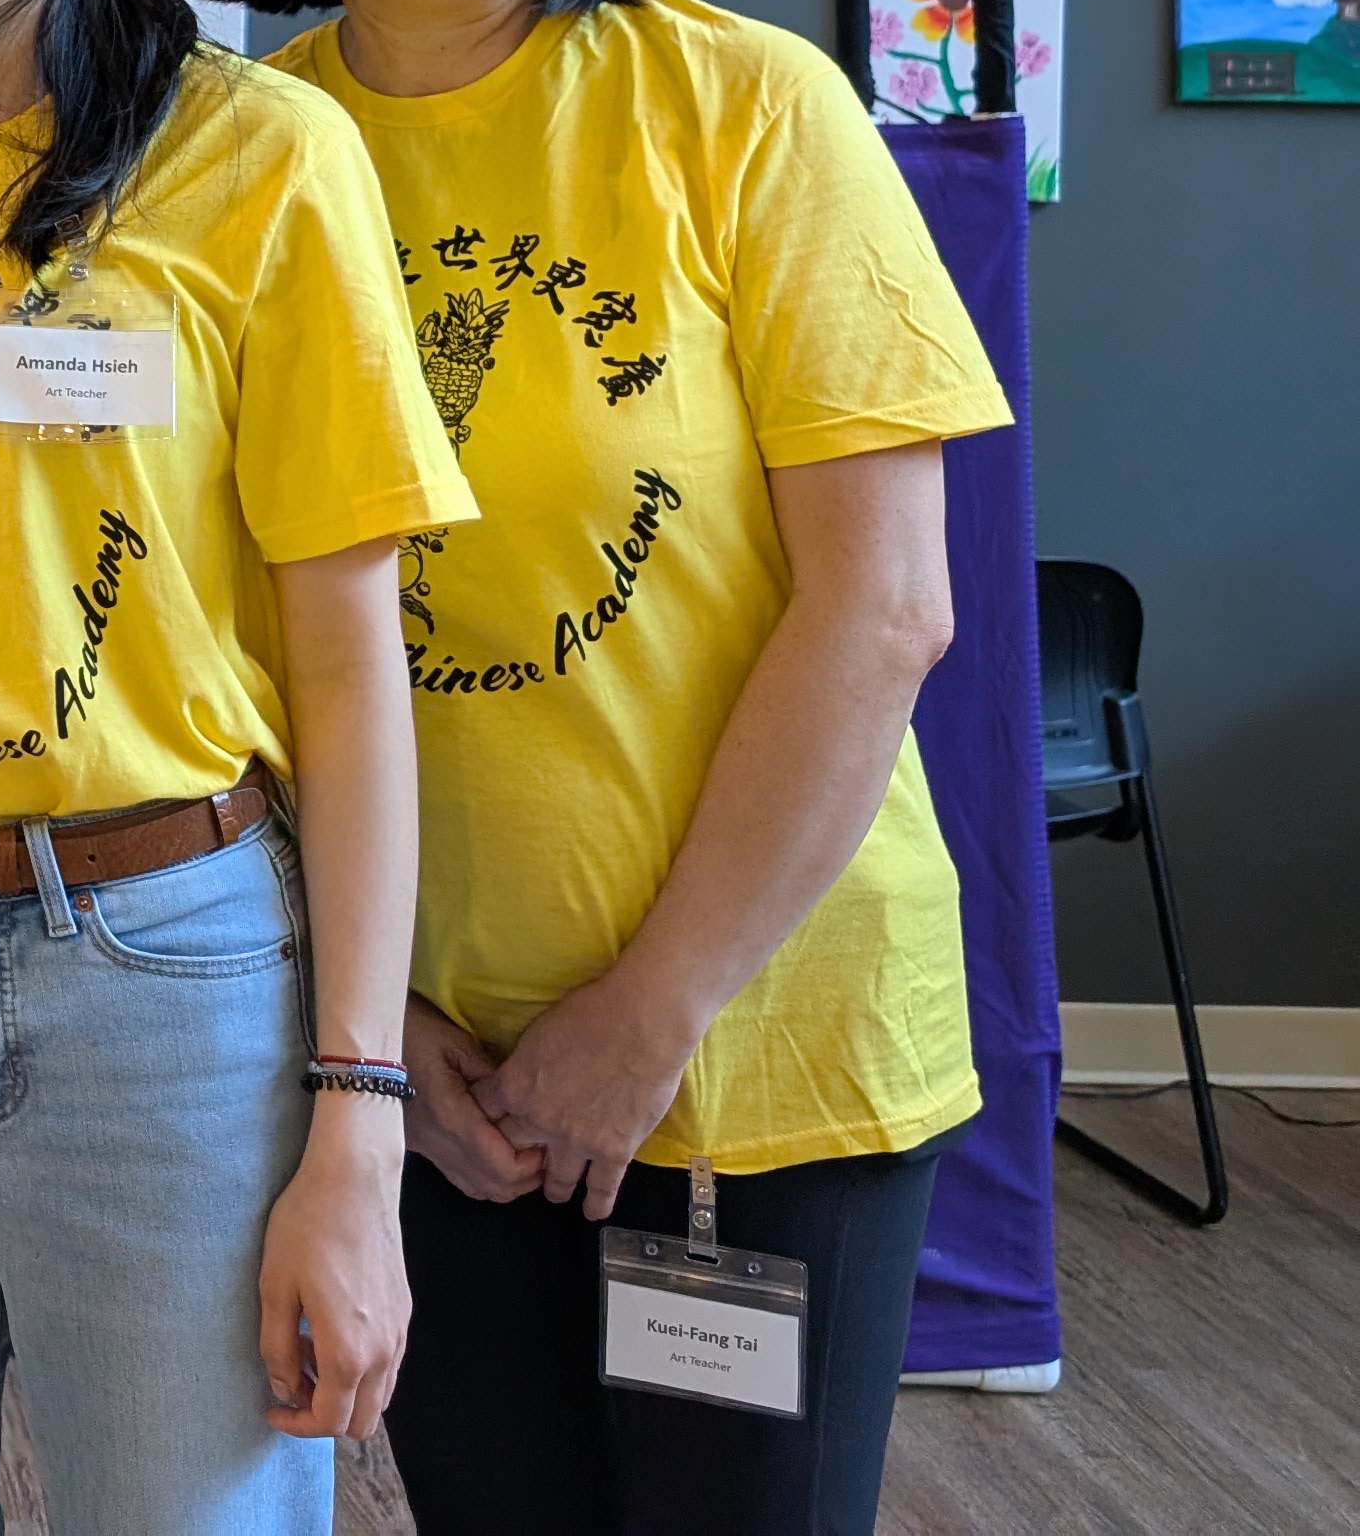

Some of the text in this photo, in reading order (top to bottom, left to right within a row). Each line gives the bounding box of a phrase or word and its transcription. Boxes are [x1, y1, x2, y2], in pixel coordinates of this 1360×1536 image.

[16, 355, 138, 374] Amanda Hsieh
[45, 387, 107, 399] Art Teacher
[404, 467, 682, 695] hinese Academy
[54, 508, 148, 740] Academy
[647, 1318, 758, 1352] Kuei-Fang Tai
[670, 1352, 732, 1373] Art Teacher
